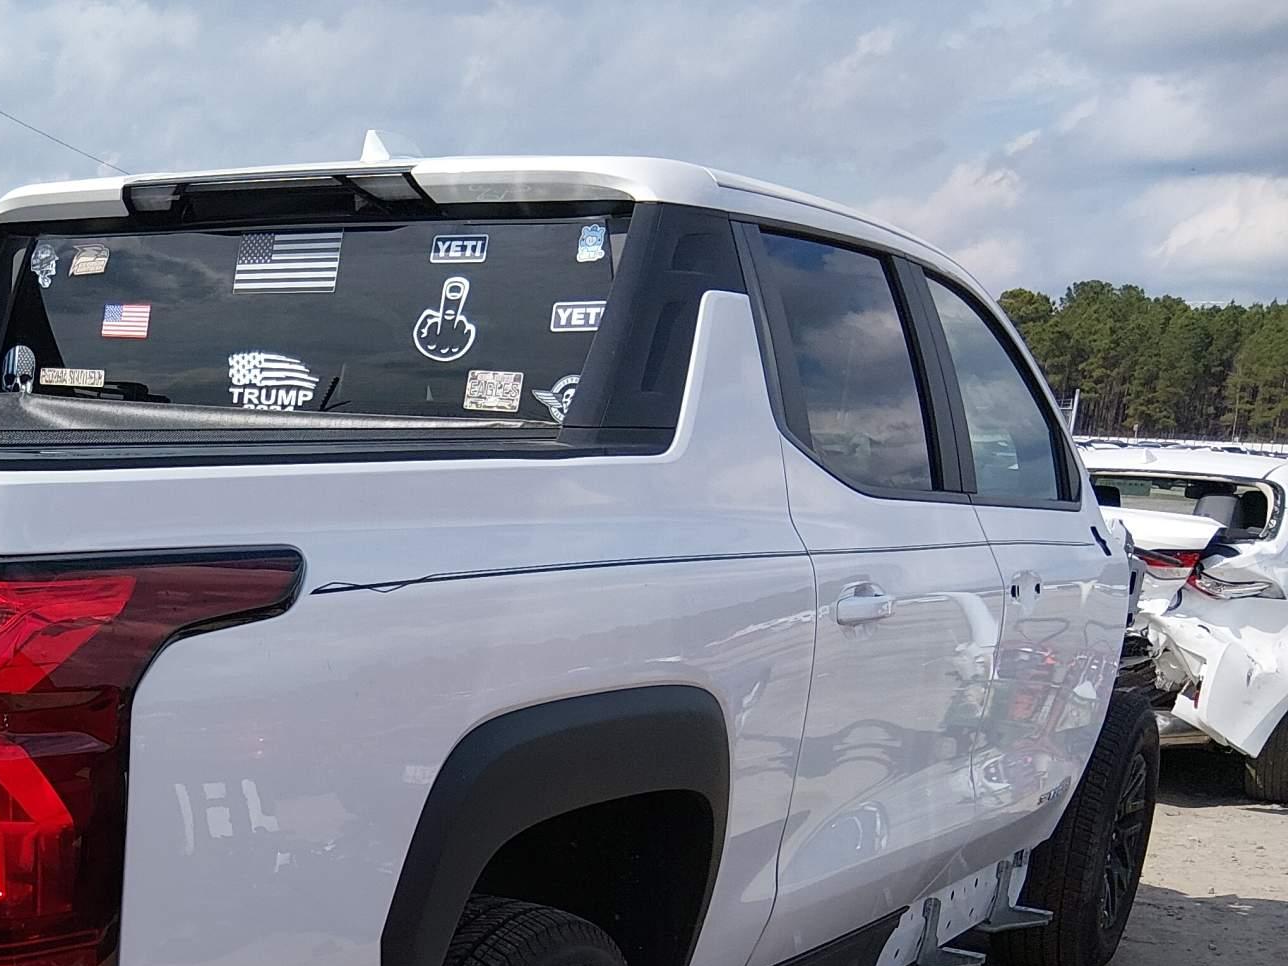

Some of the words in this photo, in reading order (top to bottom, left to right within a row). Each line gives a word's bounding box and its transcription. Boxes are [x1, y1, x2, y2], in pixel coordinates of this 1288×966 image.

[436, 240, 484, 258] YETI
[228, 387, 314, 406] TRUMP
[469, 380, 520, 398] EAGLES
